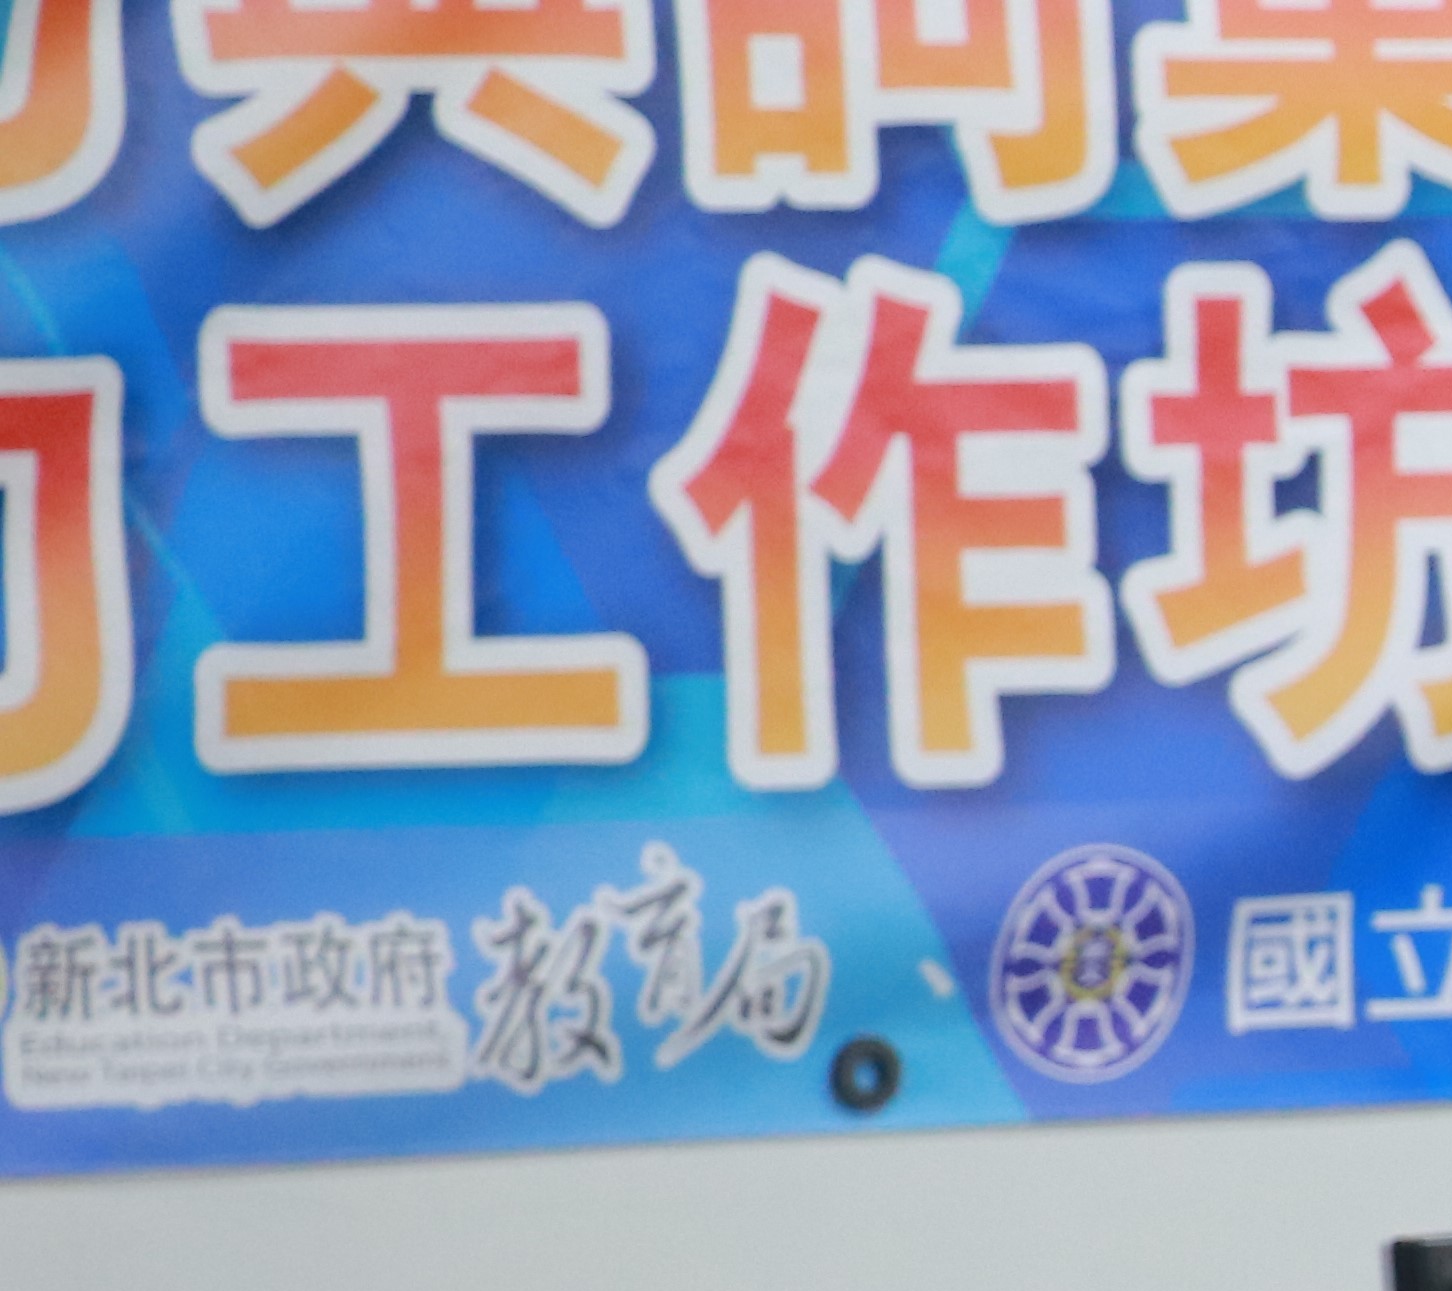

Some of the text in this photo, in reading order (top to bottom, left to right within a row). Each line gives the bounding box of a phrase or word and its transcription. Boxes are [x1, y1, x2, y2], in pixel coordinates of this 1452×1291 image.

[22, 922, 446, 1022] 新北市政府
